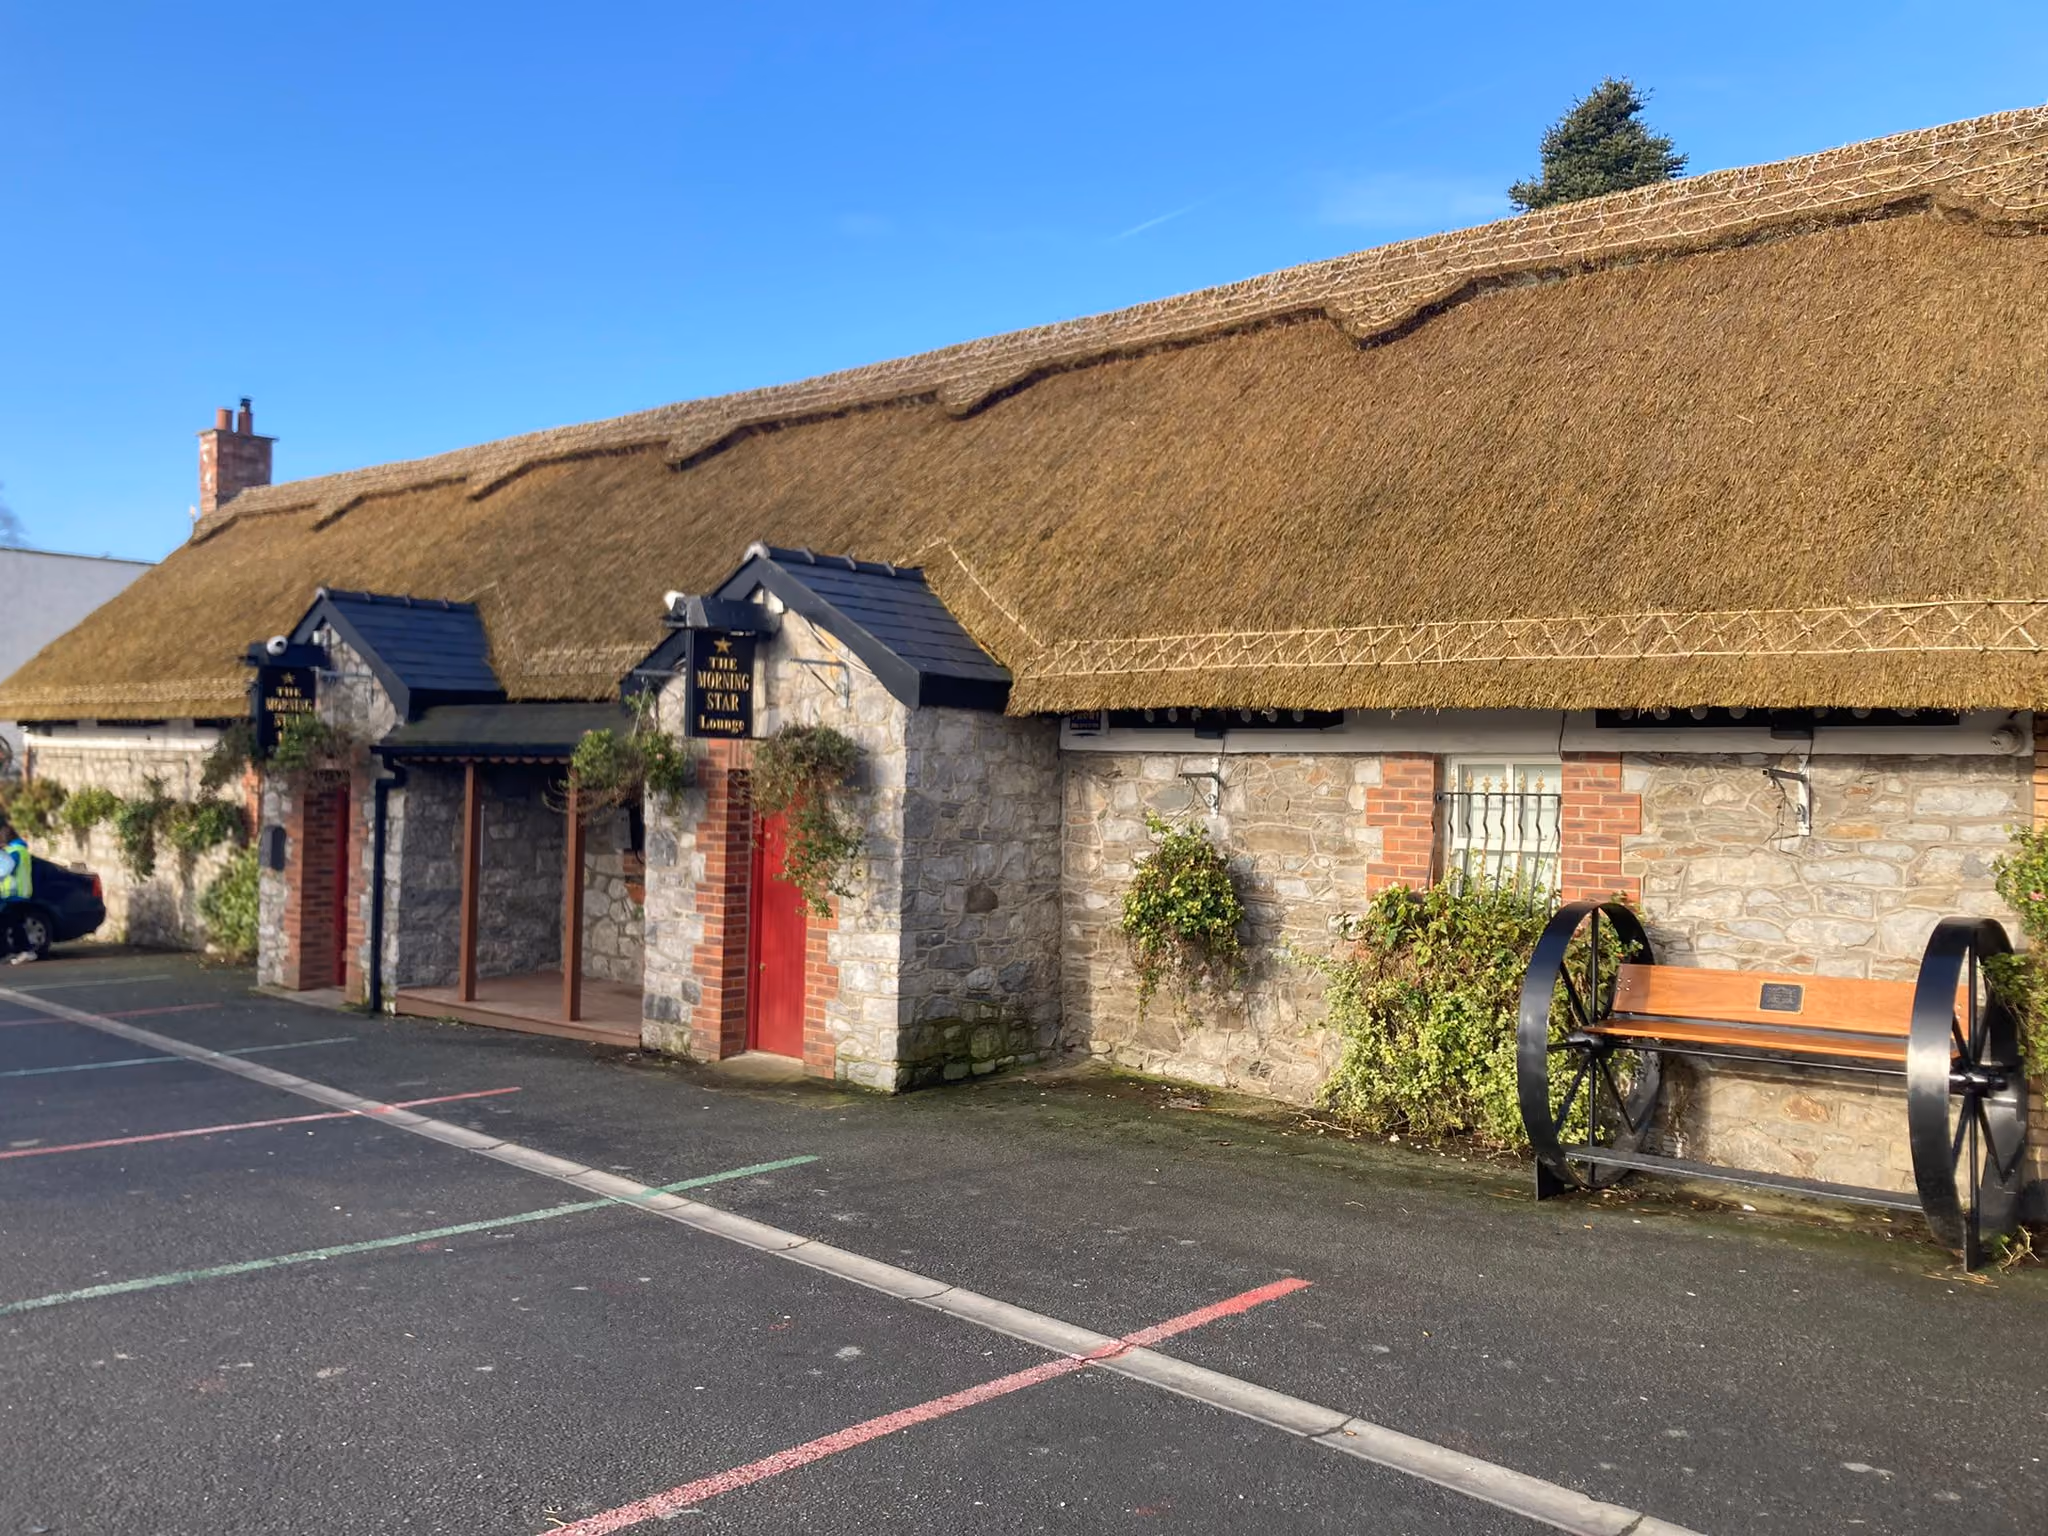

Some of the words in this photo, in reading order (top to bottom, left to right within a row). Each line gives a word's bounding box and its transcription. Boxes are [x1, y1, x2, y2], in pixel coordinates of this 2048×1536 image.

[708, 656, 738, 671] THE
[697, 670, 750, 692] MORNING
[276, 686, 302, 698] THE
[265, 697, 313, 713] MORNING
[707, 692, 739, 712] STAR
[700, 714, 745, 734] Lounge
